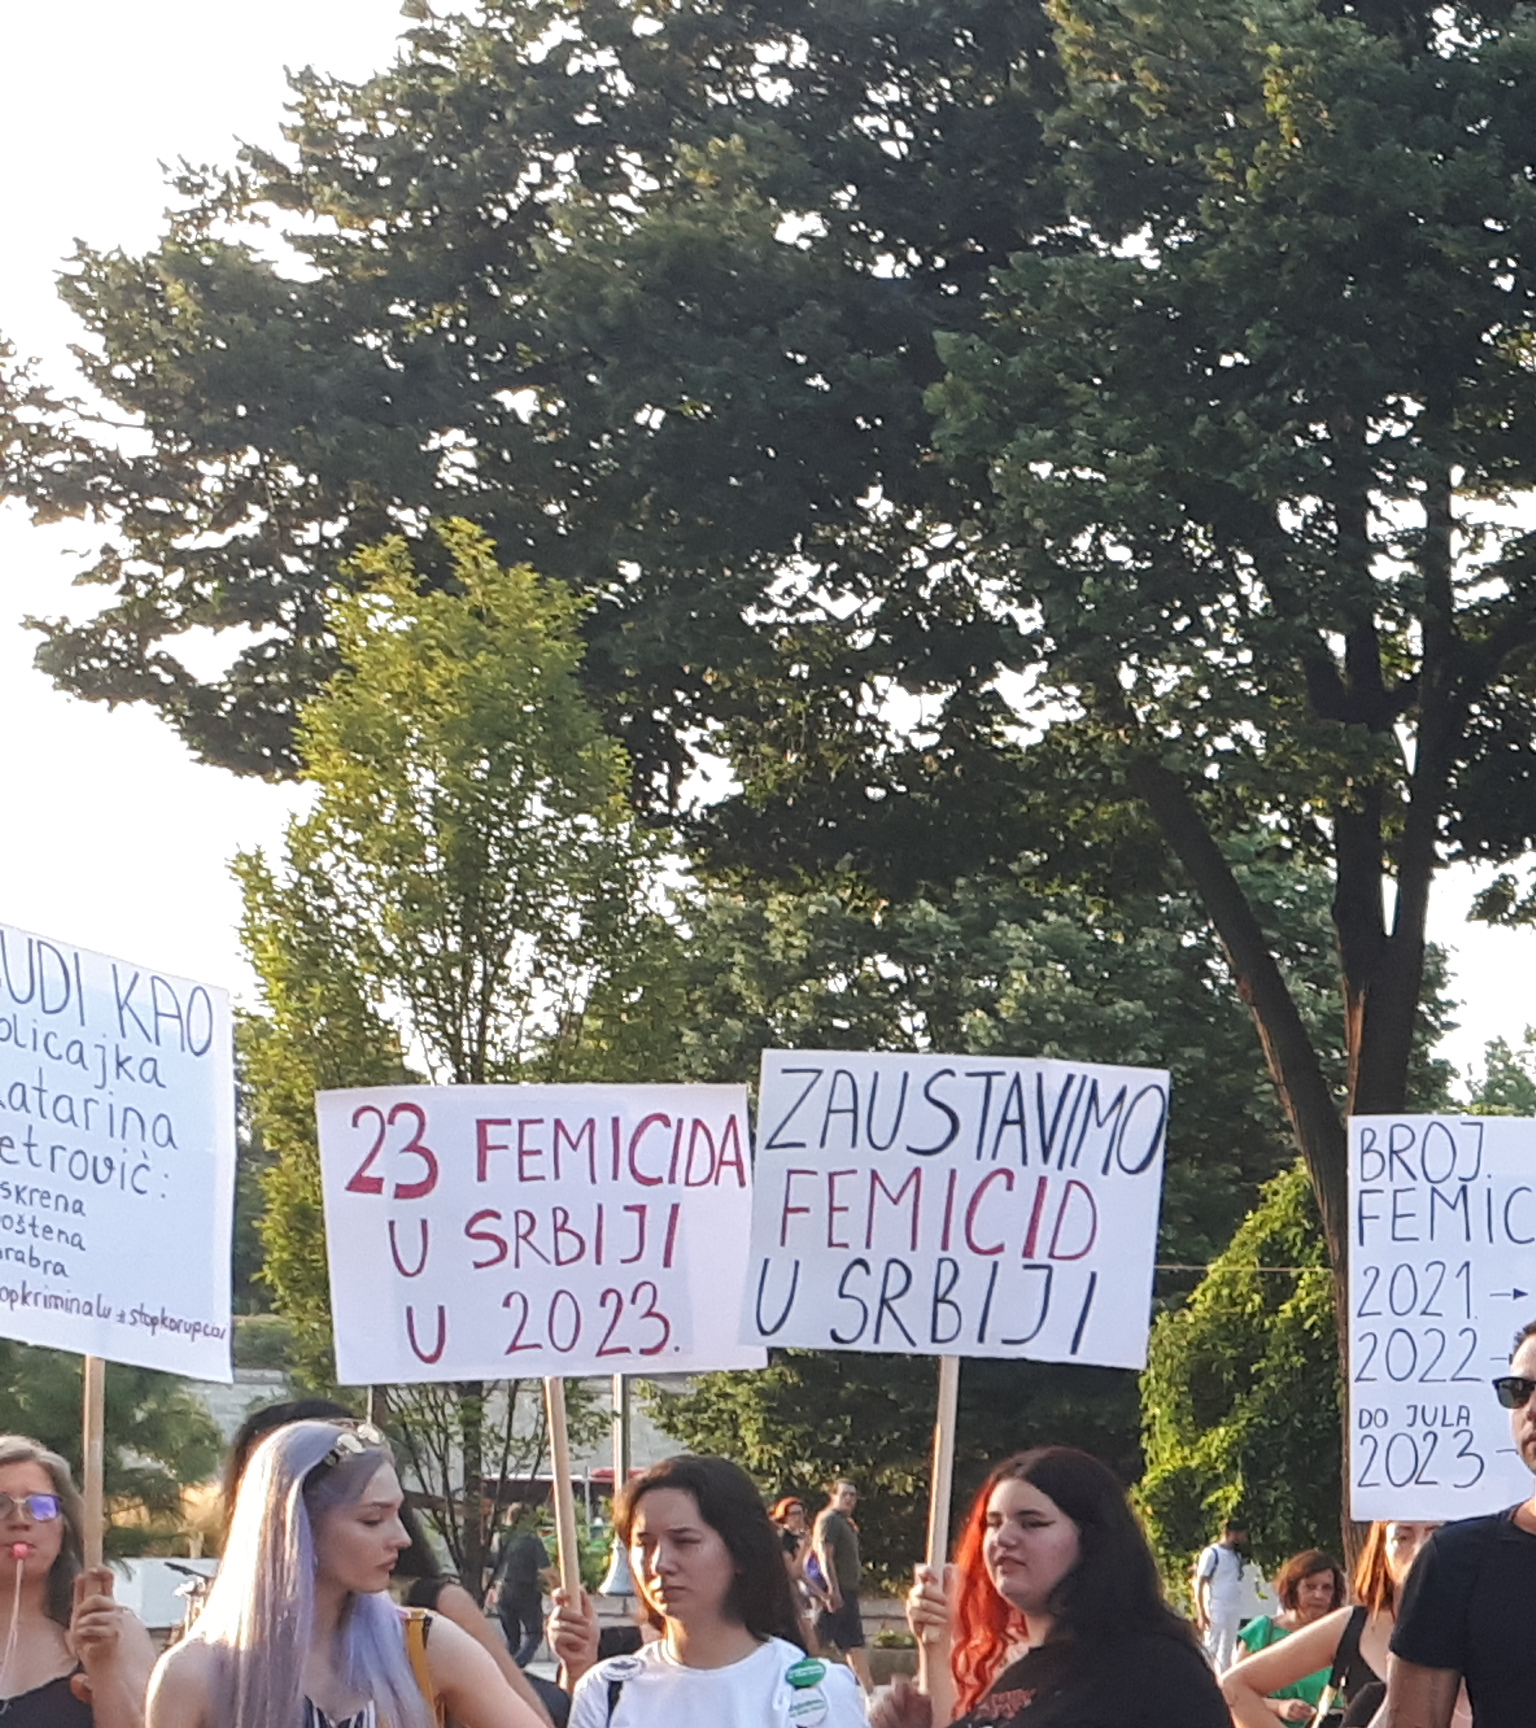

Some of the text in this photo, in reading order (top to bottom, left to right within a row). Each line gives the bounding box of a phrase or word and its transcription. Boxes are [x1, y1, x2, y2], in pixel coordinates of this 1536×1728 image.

[0, 930, 213, 1057] UDI KAO
[345, 1102, 746, 1199] 23 FEMICIDA
[765, 1069, 1168, 1176] ZAUSTAVIMO
[1361, 1121, 1483, 1184] BROJ
[388, 1203, 680, 1277] U SRBIJI
[780, 1166, 1097, 1260] FEMICID
[406, 1281, 680, 1363] U 2023.
[756, 1257, 1097, 1355] U SRBIJI
[1358, 1405, 1470, 1429] DO JULA
